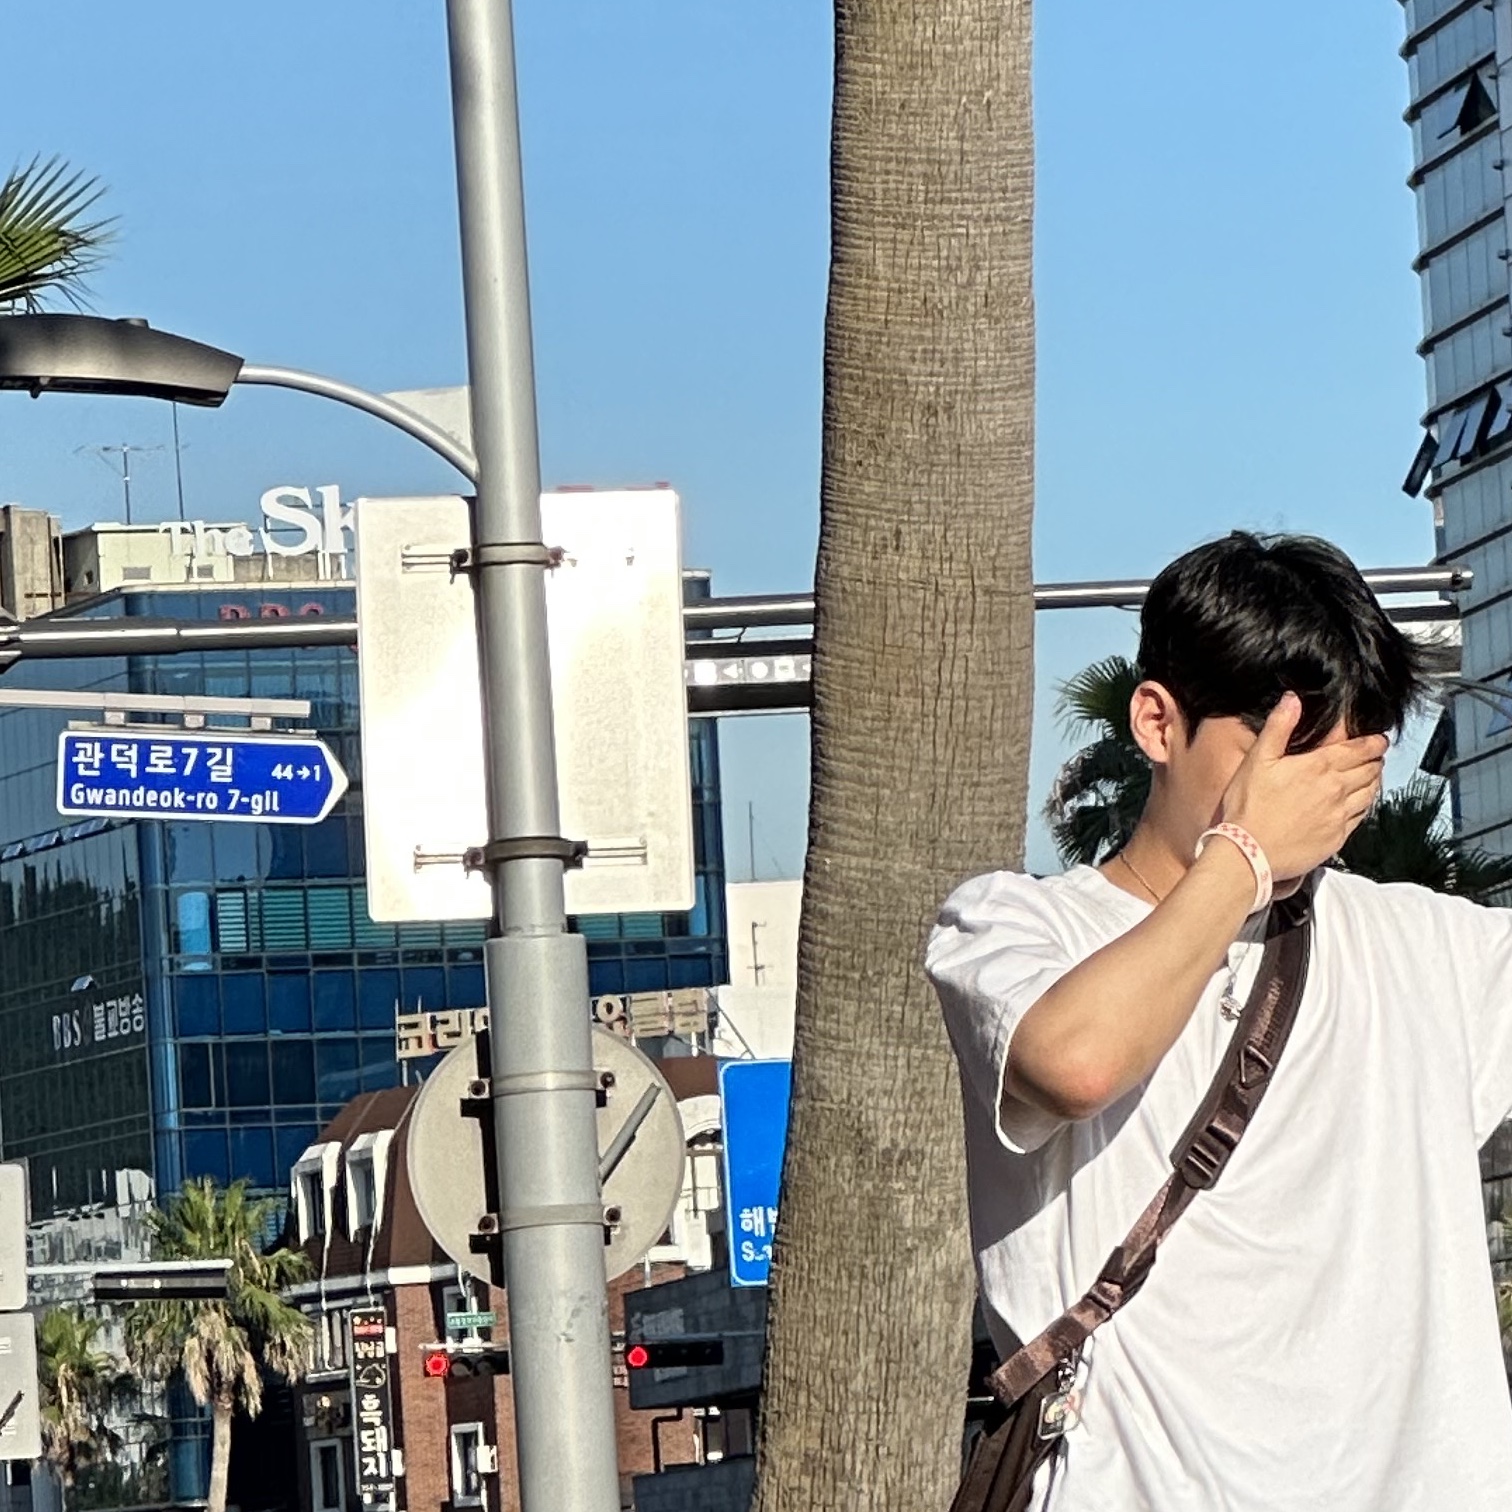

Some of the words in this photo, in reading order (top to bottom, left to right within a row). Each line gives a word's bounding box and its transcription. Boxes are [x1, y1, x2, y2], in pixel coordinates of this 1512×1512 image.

[159, 520, 254, 556] The
[72, 741, 233, 783] 관덕로7길
[70, 783, 218, 809] Gwandeok-ro
[227, 788, 280, 815] 7-gil
[52, 1009, 82, 1051] BBS
[92, 992, 145, 1041] 불교방송
[359, 1393, 388, 1478] 흑돼지
